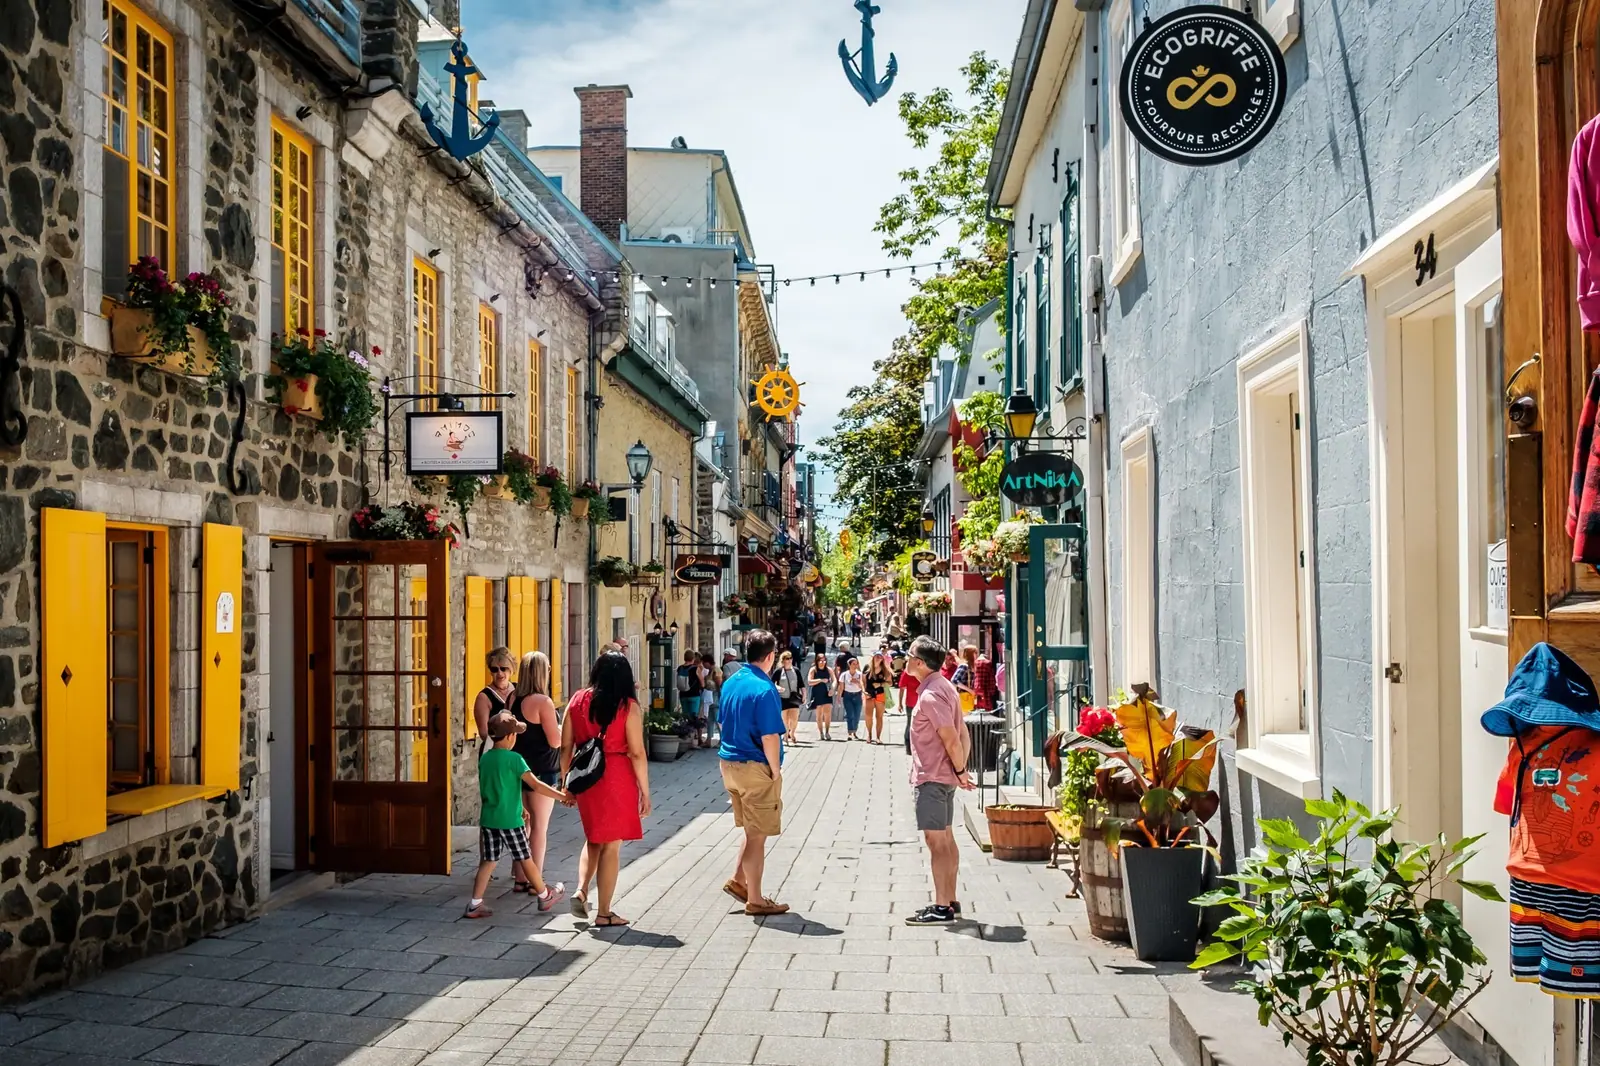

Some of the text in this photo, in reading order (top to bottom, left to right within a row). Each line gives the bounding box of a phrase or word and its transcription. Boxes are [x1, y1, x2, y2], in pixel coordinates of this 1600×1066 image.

[1144, 26, 1261, 79] ECOGRIFFE
[1144, 88, 1264, 144] FOURRURE RECYCLÉE
[1414, 233, 1438, 286] 34
[1490, 566, 1507, 586] OUVE
